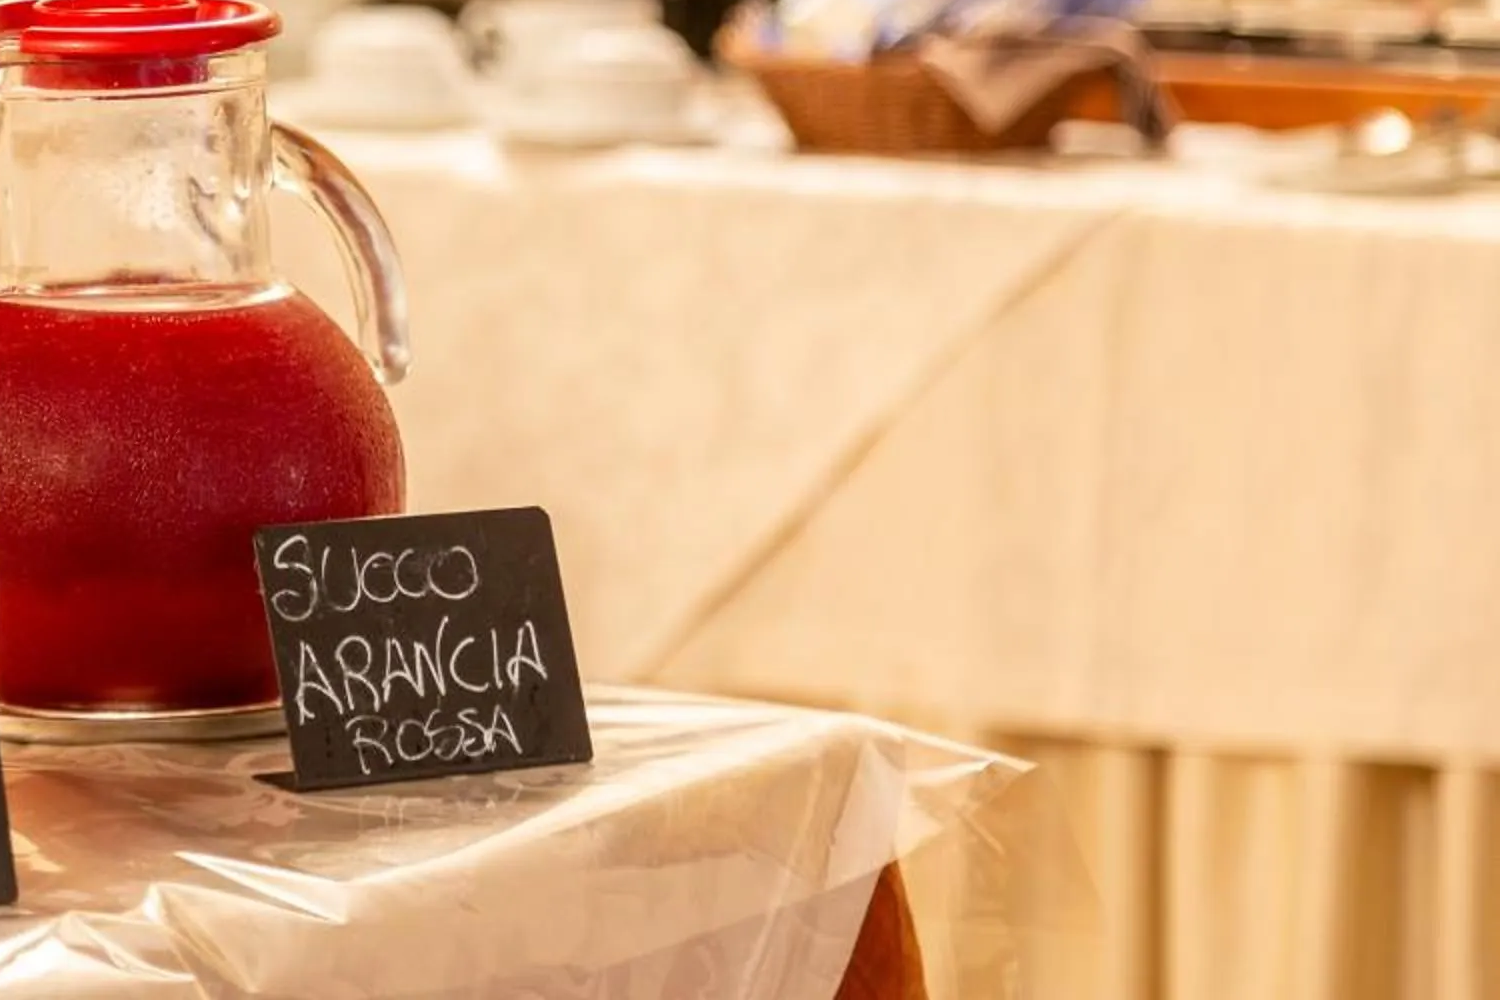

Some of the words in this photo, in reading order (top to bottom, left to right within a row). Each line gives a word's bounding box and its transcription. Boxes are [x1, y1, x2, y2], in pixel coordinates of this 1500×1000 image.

[271, 534, 479, 622] SUCCO
[294, 615, 548, 726] ARANCIA
[345, 703, 523, 775] ROSSA
